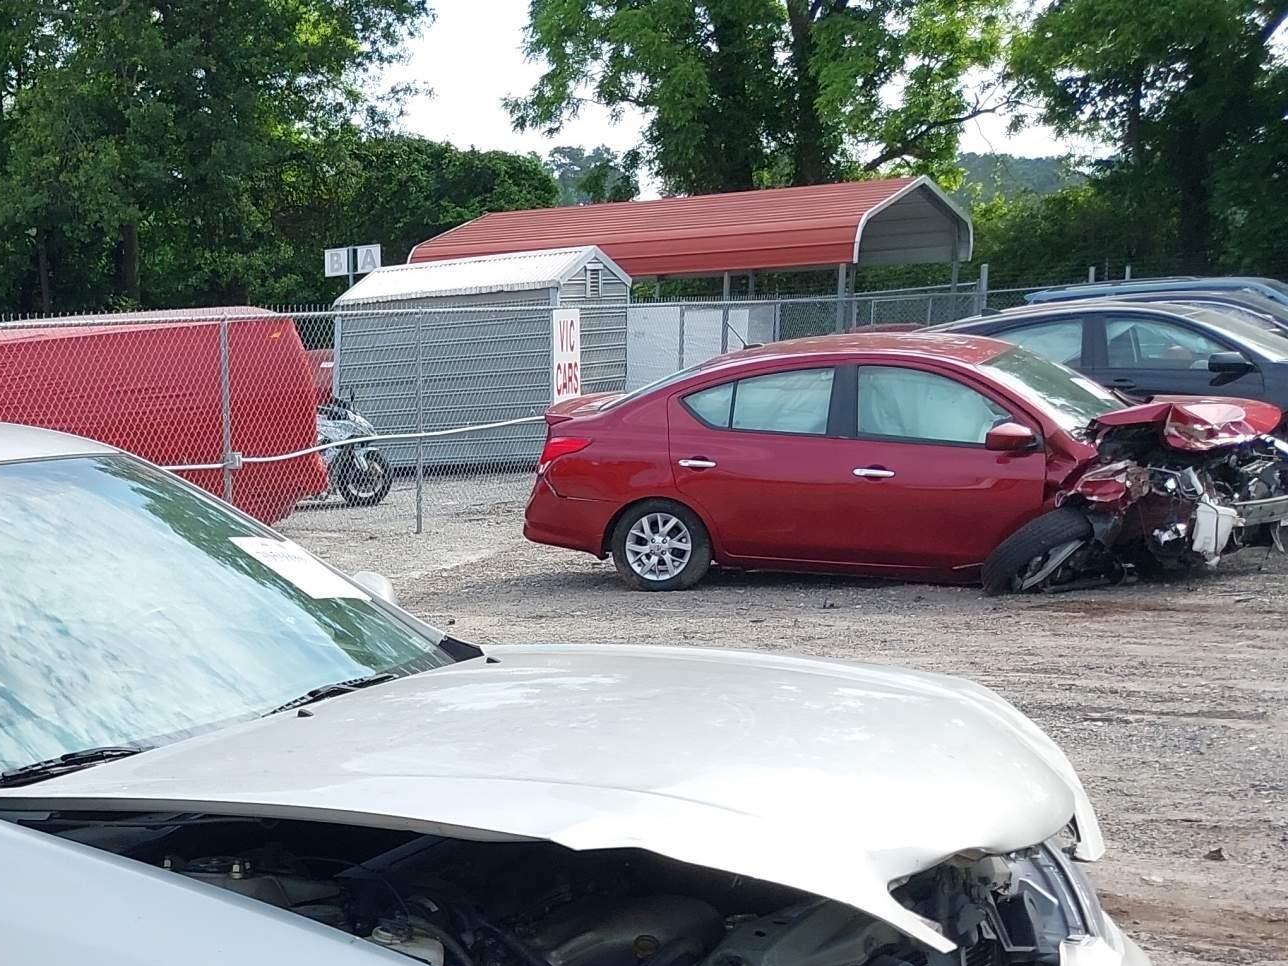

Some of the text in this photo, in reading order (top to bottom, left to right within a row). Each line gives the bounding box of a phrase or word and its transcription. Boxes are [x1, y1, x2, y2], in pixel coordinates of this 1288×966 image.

[329, 248, 378, 273] B A
[559, 319, 575, 353] VIC
[555, 361, 579, 396] CARS
